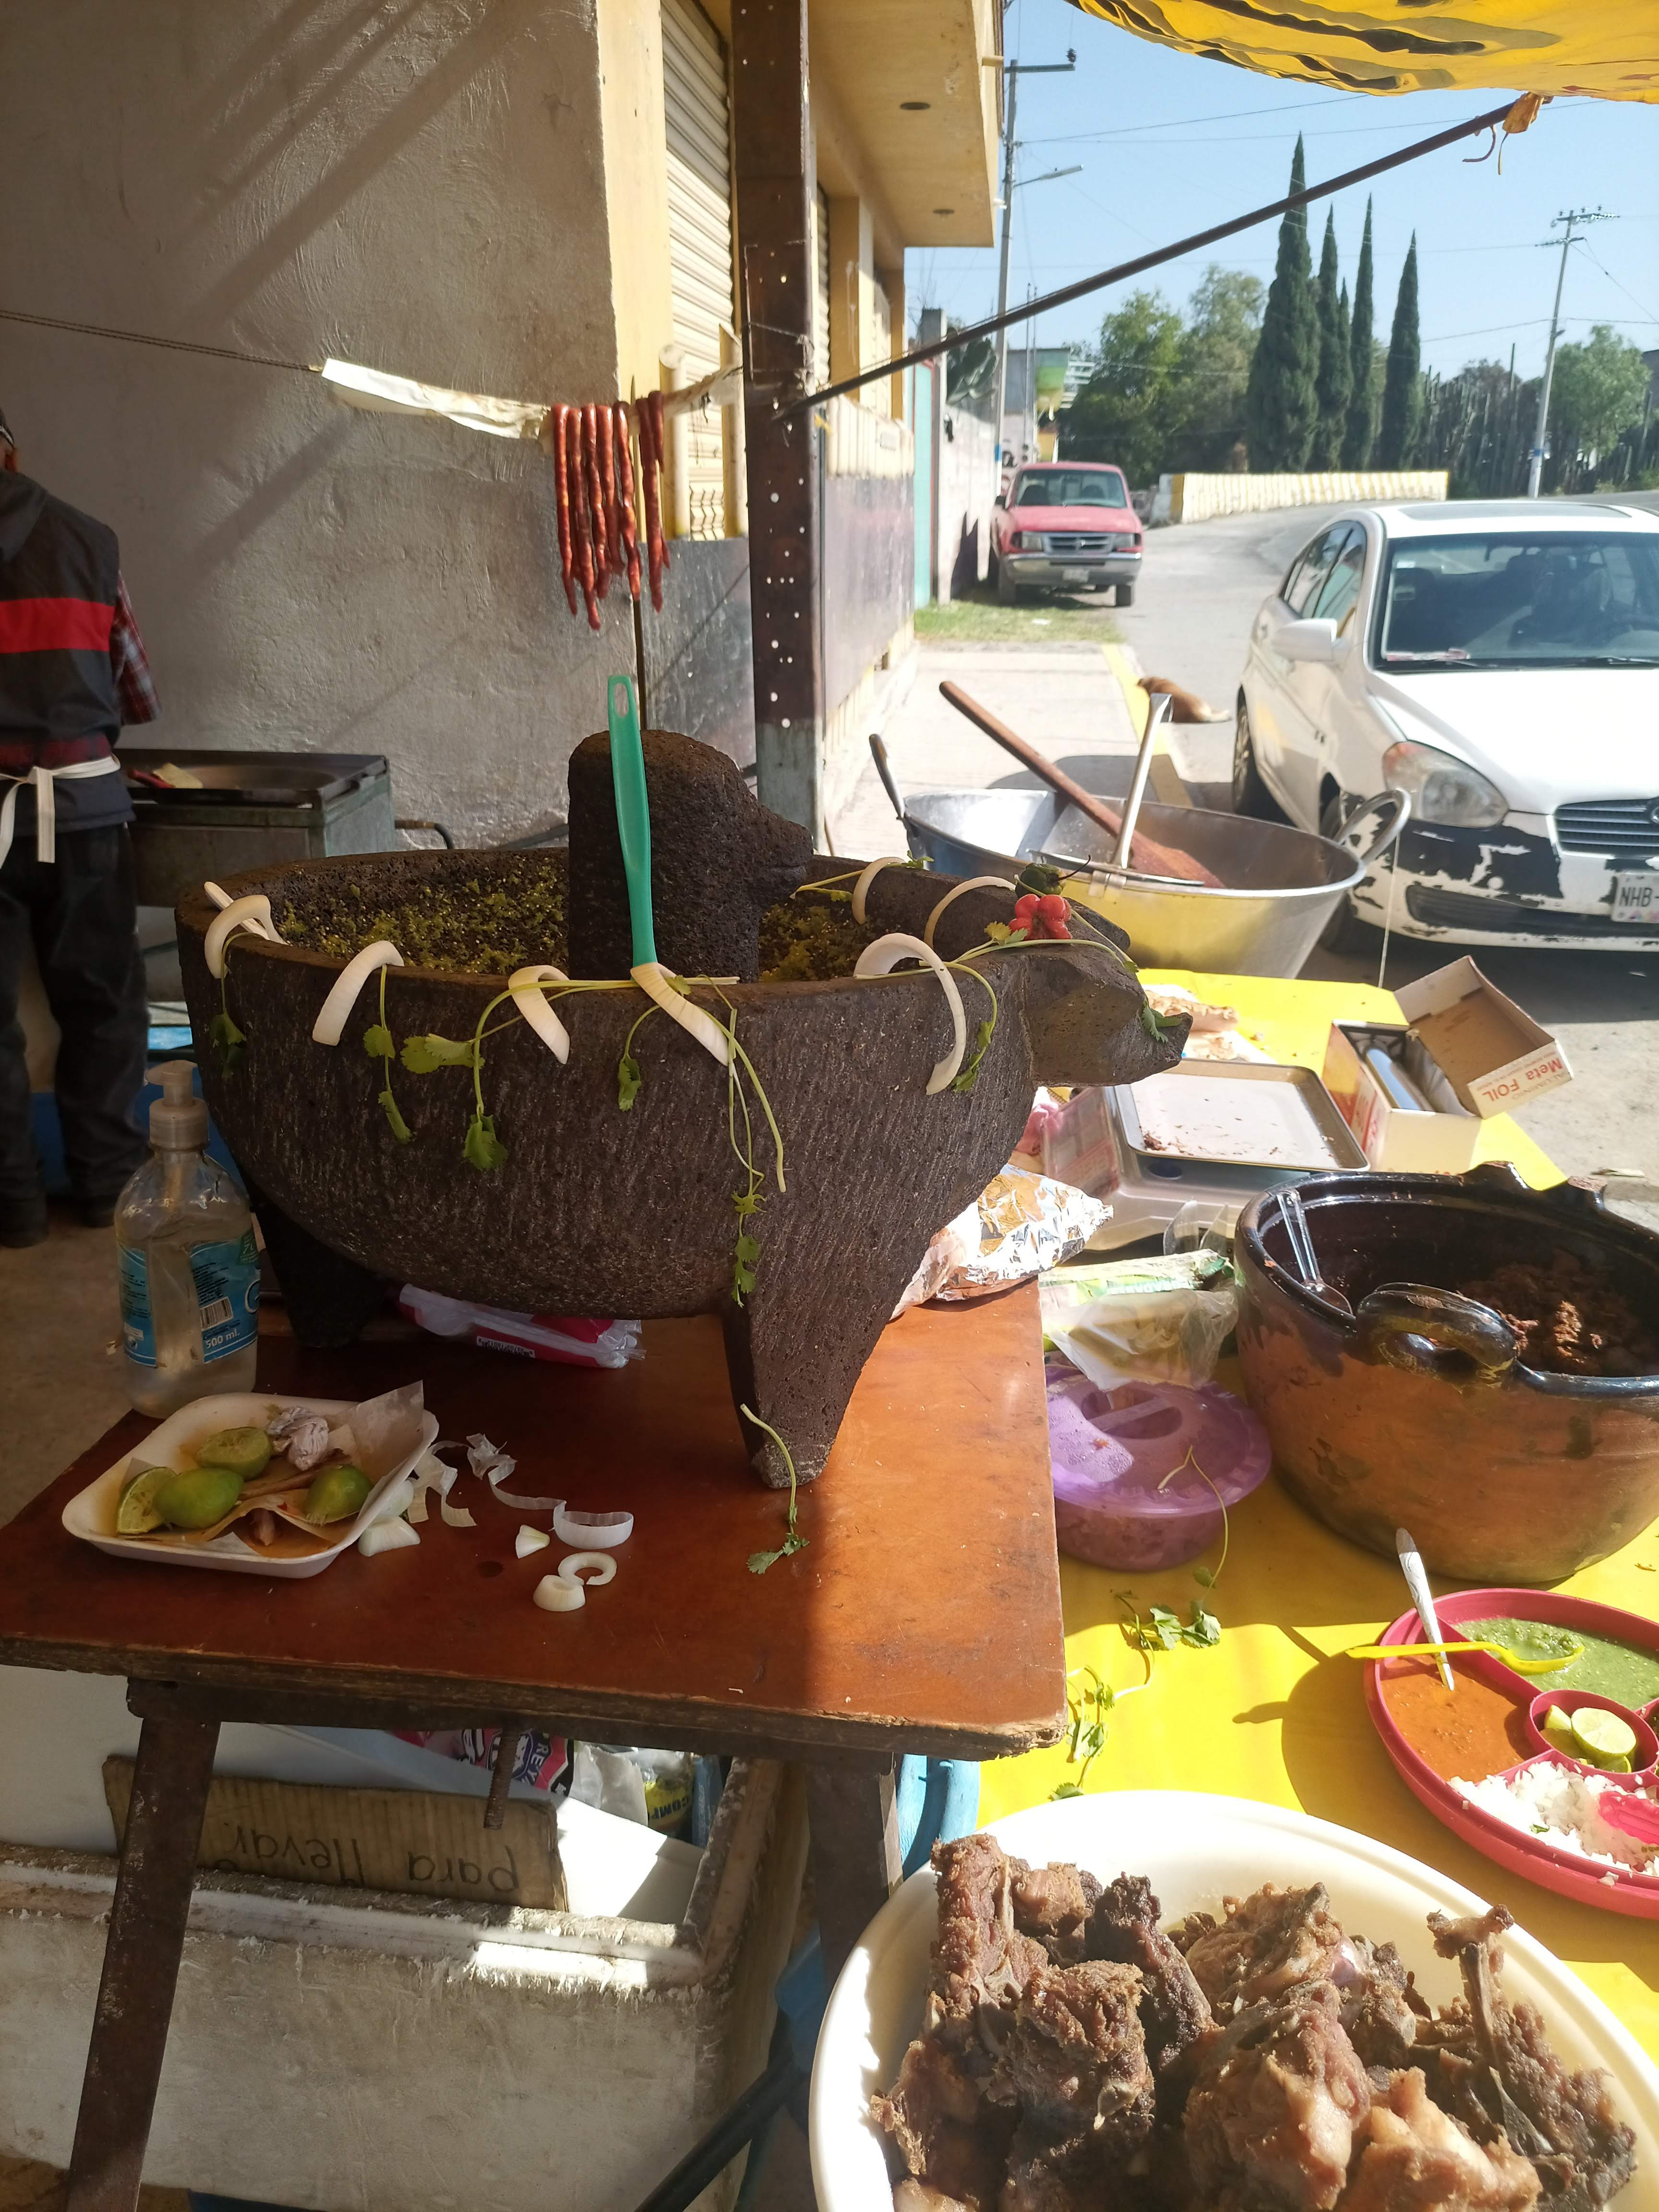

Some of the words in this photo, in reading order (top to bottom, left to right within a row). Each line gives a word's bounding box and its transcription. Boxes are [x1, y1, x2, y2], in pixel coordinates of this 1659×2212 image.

[1526, 1058, 1563, 1080] Meta
[1482, 1078, 1520, 1101] FOIL
[206, 1335, 223, 1349] 500
[406, 1844, 520, 1893] para
